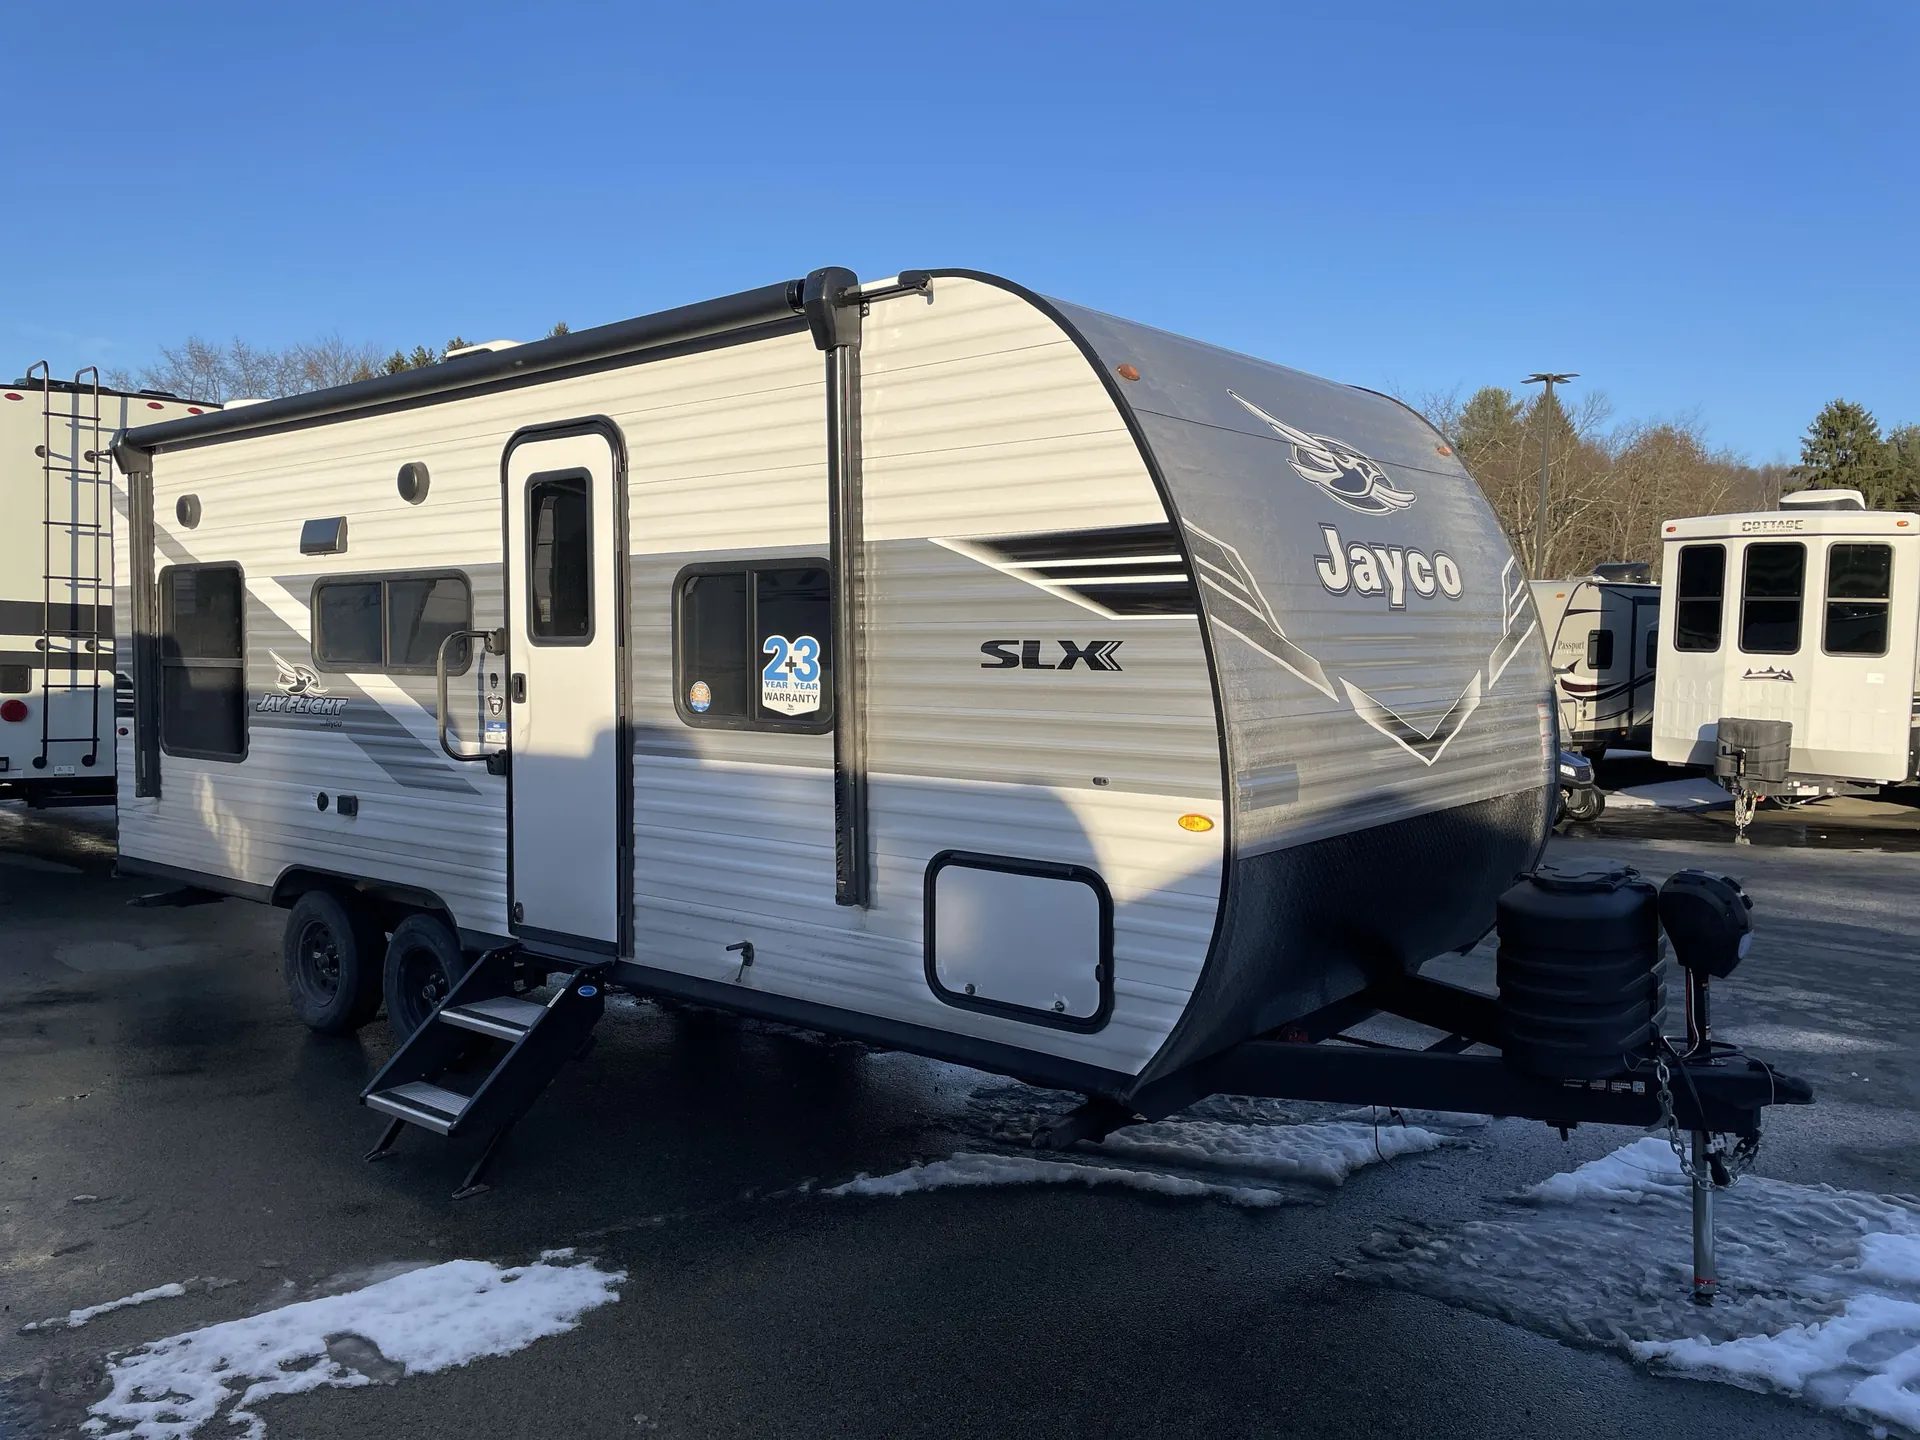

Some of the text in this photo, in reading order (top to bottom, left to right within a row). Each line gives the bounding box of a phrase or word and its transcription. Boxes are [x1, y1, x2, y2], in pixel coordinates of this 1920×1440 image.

[1742, 520, 1804, 531] COTTAGE
[1313, 522, 1464, 611] Jayco
[1557, 641, 1585, 652] Passport
[981, 640, 1124, 671] SLX
[794, 682, 818, 690] YEAR
[256, 693, 348, 715] JAY FLIGHT
[764, 692, 818, 704] WARRANTY
